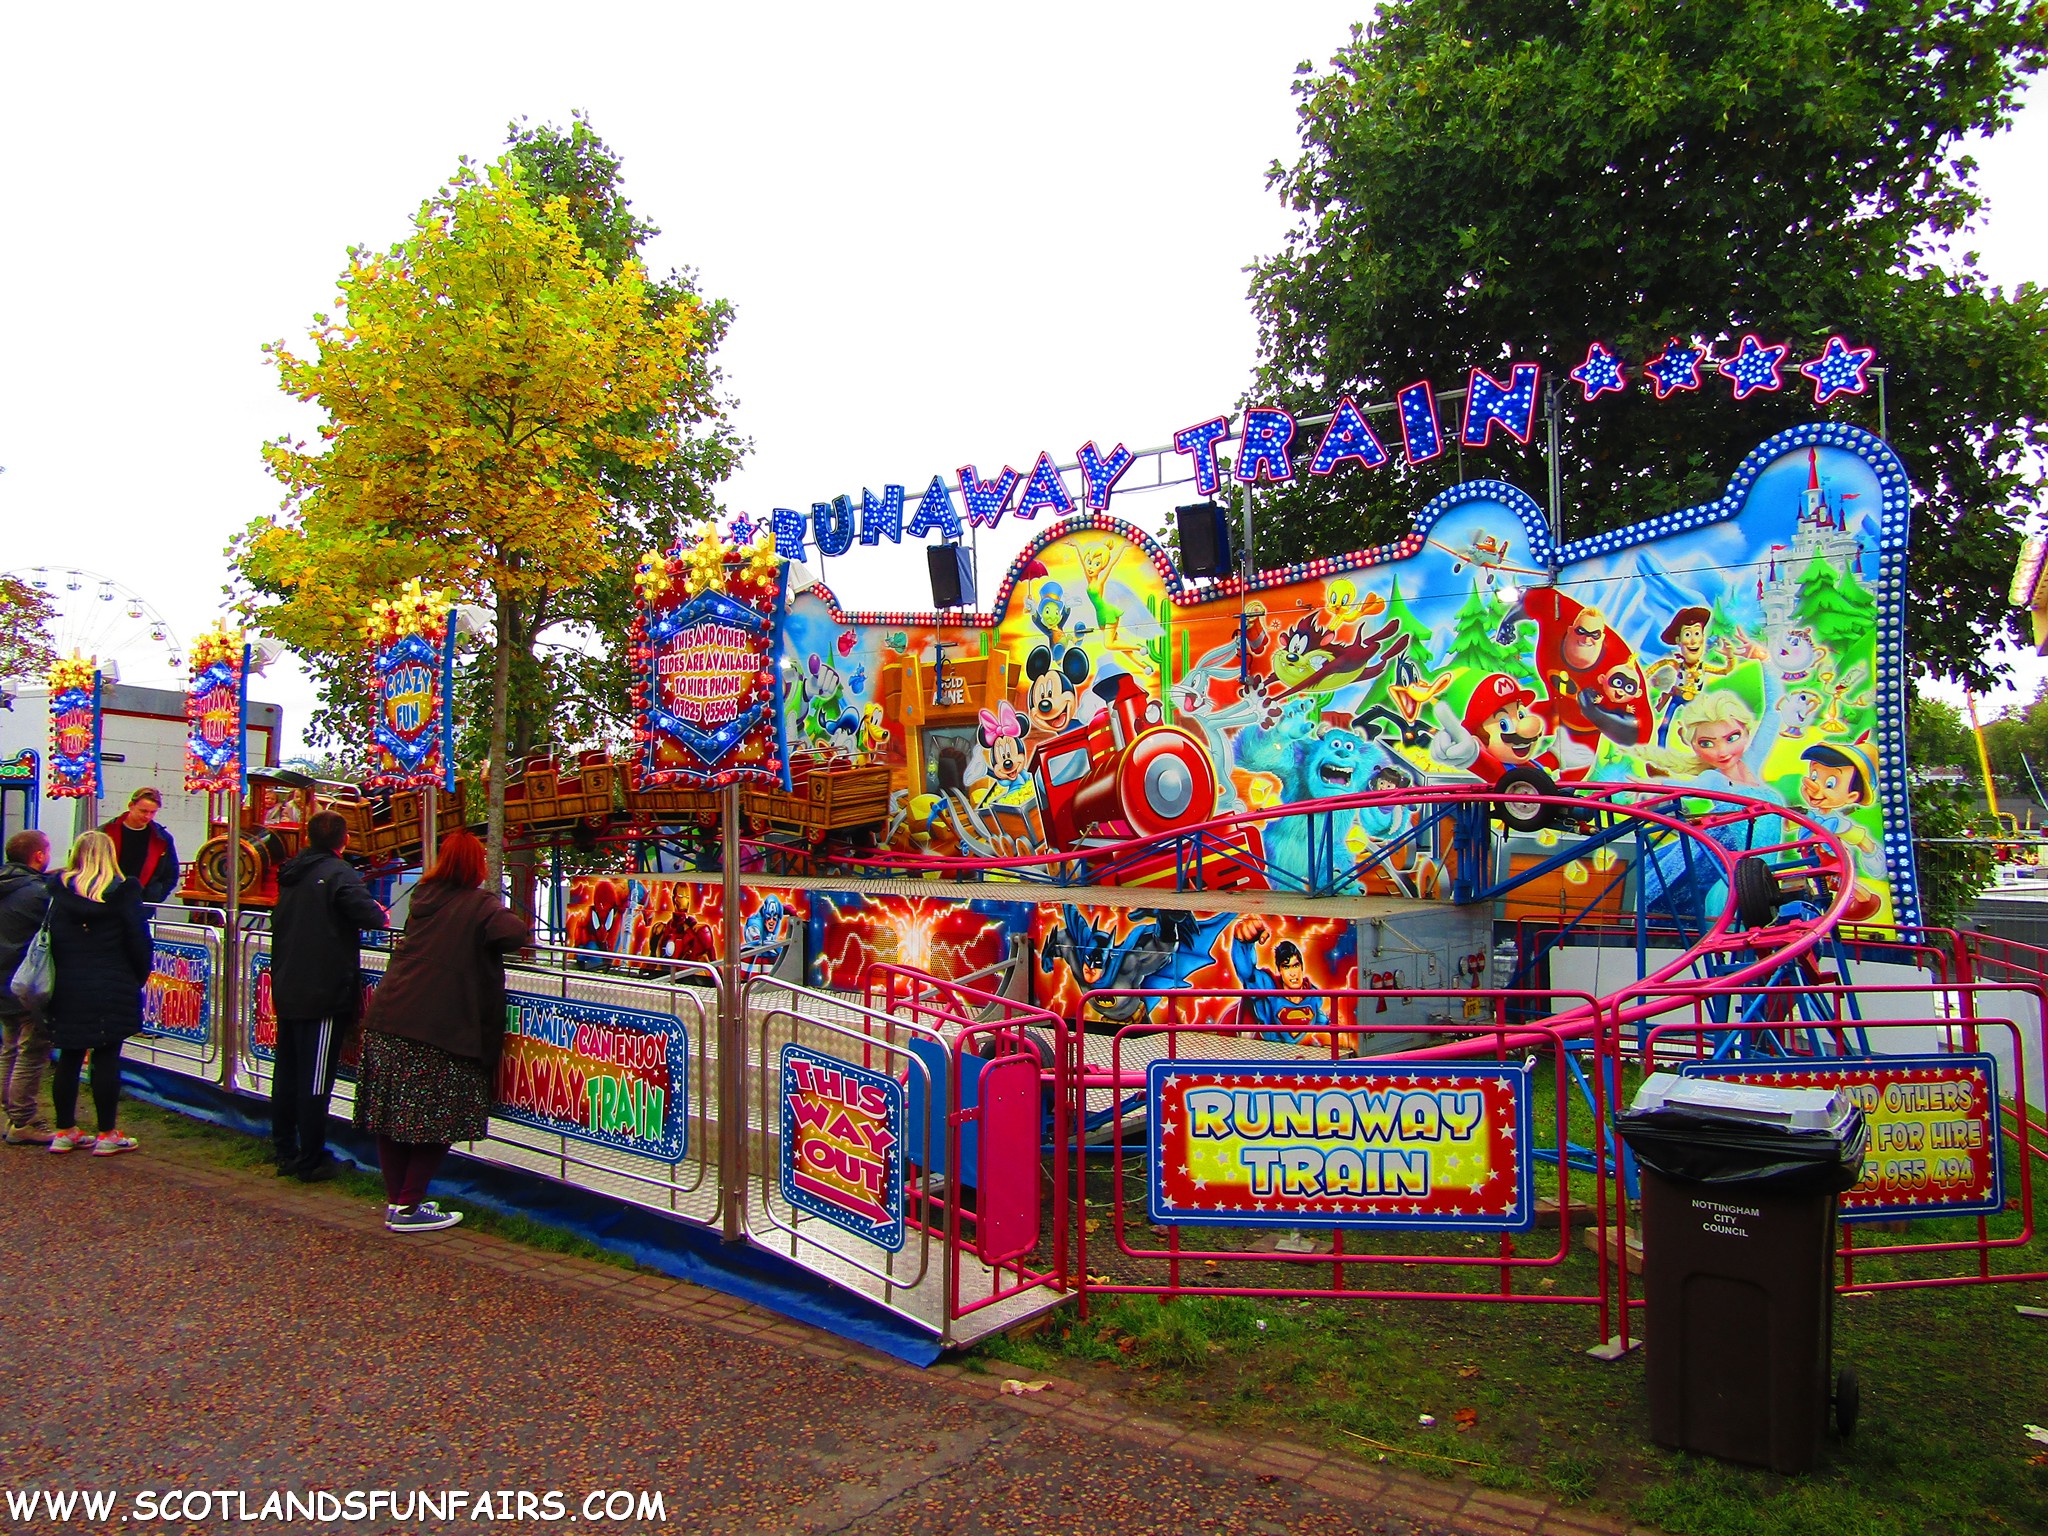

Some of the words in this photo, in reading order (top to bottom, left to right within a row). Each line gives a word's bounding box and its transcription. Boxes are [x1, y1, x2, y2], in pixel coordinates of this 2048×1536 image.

[770, 440, 1136, 563] RUNAWAY
[1173, 363, 1540, 495] TRAIN
[673, 628, 695, 653] THIS
[695, 622, 717, 647] AND
[717, 624, 747, 650] OTHER
[659, 653, 686, 675] RIDES
[686, 649, 706, 672] ARE
[706, 648, 760, 674] AVAILABLE
[385, 663, 432, 700] CRAZY
[674, 676, 687, 695] TO
[687, 676, 708, 699] HIRE
[709, 675, 741, 698] PHONE
[395, 701, 420, 732] FUN
[673, 697, 702, 722] 07825
[704, 697, 738, 724] 955494
[0, 765, 31, 777] OX
[162, 988, 200, 1030] TRAIN
[522, 1006, 577, 1052] FAMILY
[577, 1023, 613, 1062] CAN
[614, 1029, 668, 1069] ENJOY
[788, 1057, 887, 1120] THIS
[1884, 1080, 1974, 1114] OTHERS
[586, 1069, 664, 1145] TRAIN
[1187, 1089, 1484, 1143] RUNAWAY
[786, 1093, 898, 1160] WAY
[1877, 1121, 1925, 1152] FOR
[1930, 1119, 1984, 1149] HIRE
[802, 1138, 884, 1194] OUT
[1241, 1146, 1430, 1197] TRAIN
[1884, 1159, 1929, 1191] 955
[1931, 1157, 1975, 1189] 494
[1692, 1199, 1760, 1216] NOTTINGHAM
[1713, 1213, 1737, 1224] CITY
[1702, 1222, 1749, 1237] COUNCIL
